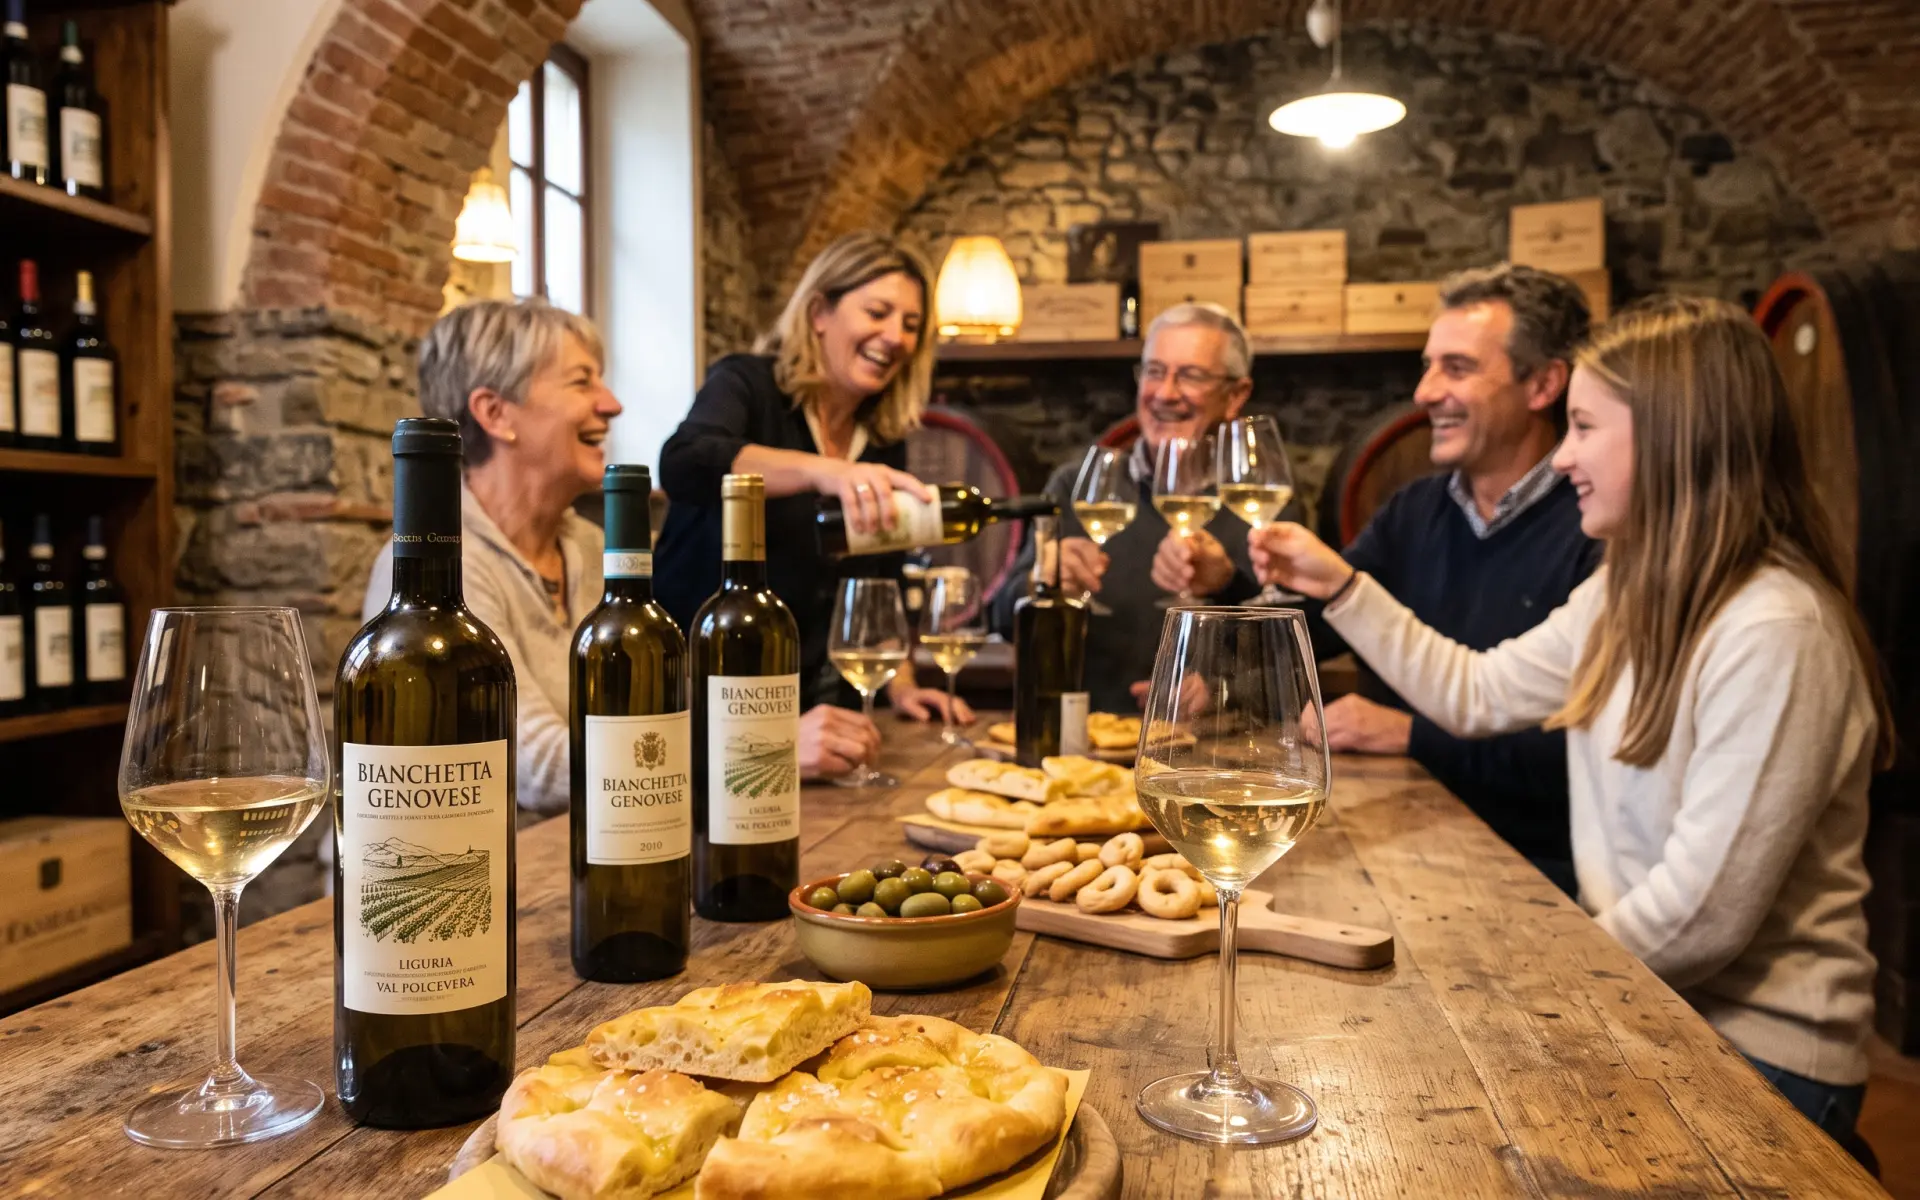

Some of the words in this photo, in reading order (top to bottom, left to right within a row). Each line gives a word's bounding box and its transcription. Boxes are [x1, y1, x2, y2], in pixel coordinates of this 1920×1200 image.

[721, 684, 796, 700] BIANCHETTA
[727, 701, 793, 716] GENOVESE
[358, 760, 492, 784] BIANCHETTA
[602, 773, 688, 791] BIANCHETTA
[367, 786, 482, 809] GENOVESE
[611, 789, 684, 808] GENOVESE
[639, 840, 663, 852] 2010
[399, 957, 454, 970] LIGURIA
[376, 982, 399, 993] VAL
[402, 977, 475, 993] POLCEVERA
